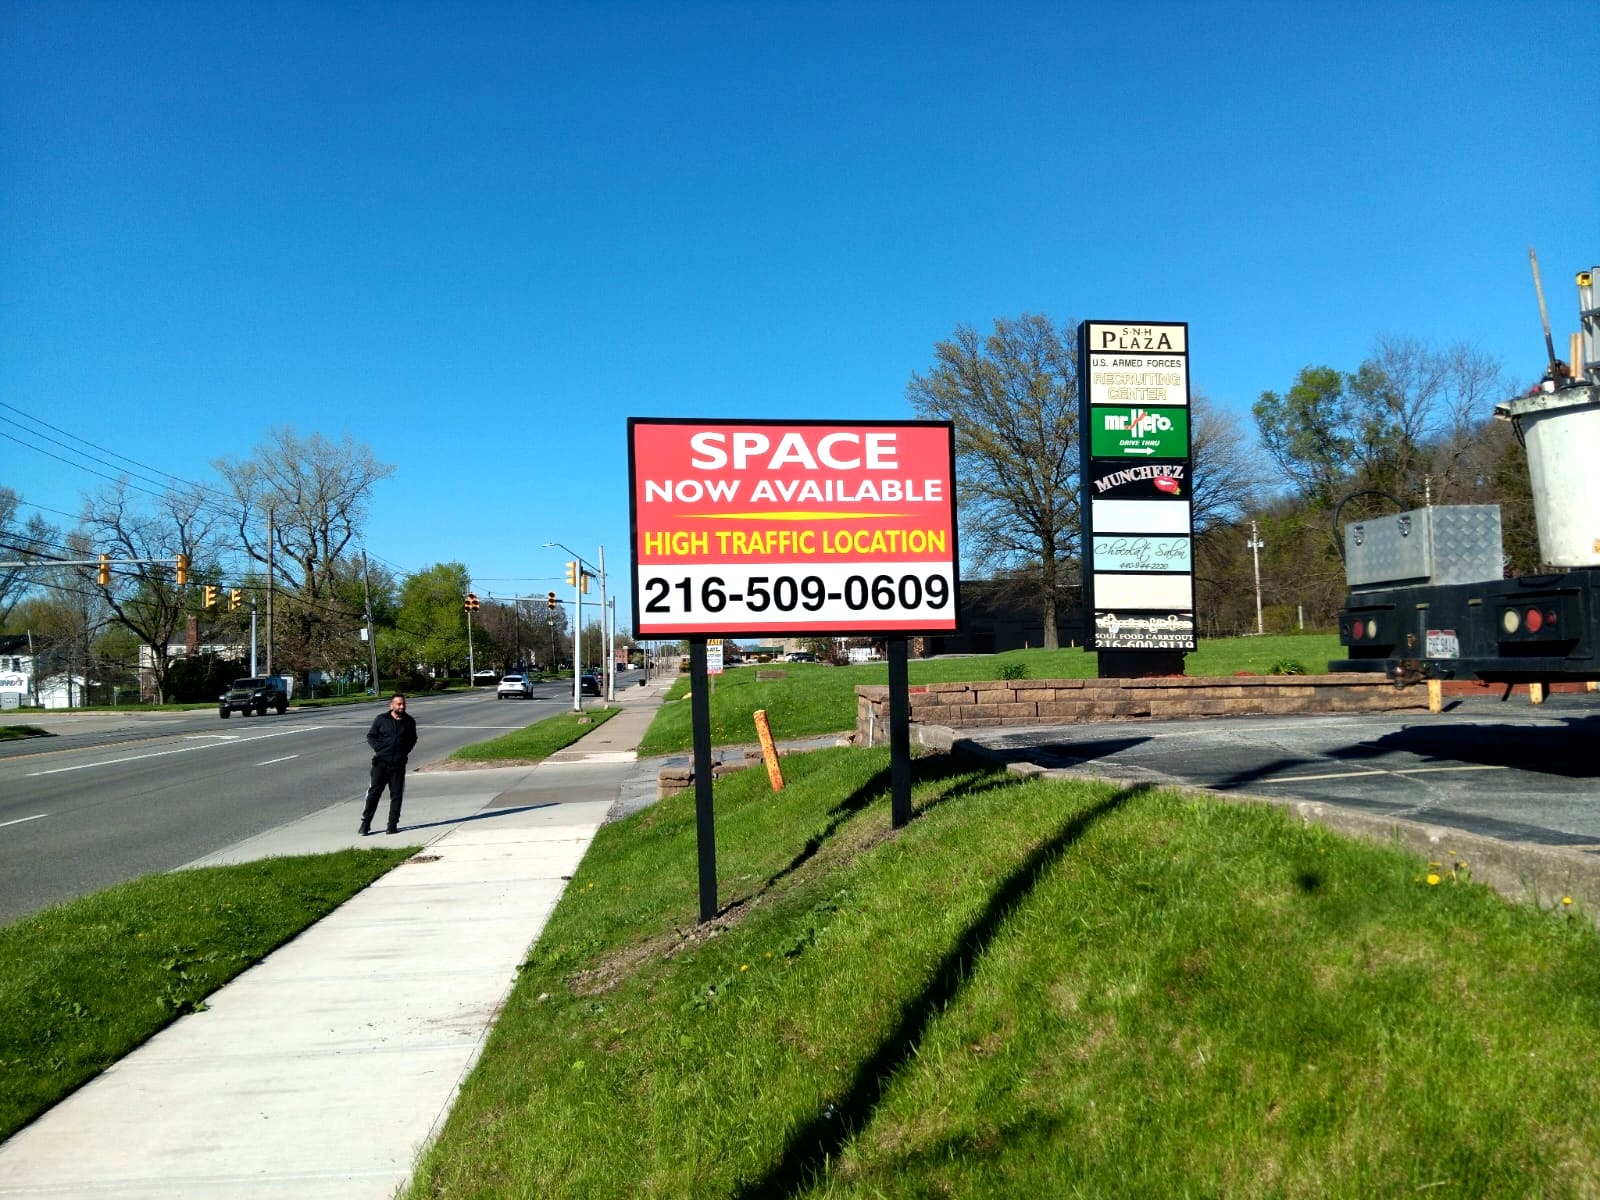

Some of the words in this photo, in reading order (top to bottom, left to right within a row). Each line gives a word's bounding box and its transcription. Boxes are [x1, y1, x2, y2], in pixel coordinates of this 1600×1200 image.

[1102, 331, 1173, 350] PLAZA
[1092, 359, 1108, 367] U.S.
[1112, 359, 1143, 368] ARMED
[1147, 360, 1181, 368] FORCES
[1093, 372, 1181, 386] RECRUITING
[1108, 387, 1167, 401] CENTER
[690, 432, 899, 470] SPACE
[1094, 465, 1184, 493] MUNCHEEZ
[644, 480, 741, 502] NOW
[749, 480, 943, 502] AVAILABLE
[644, 531, 708, 555] HIGH
[716, 530, 815, 555] TRAFFIC
[823, 529, 946, 553] LOCATION
[645, 574, 949, 613] 216-509-0609
